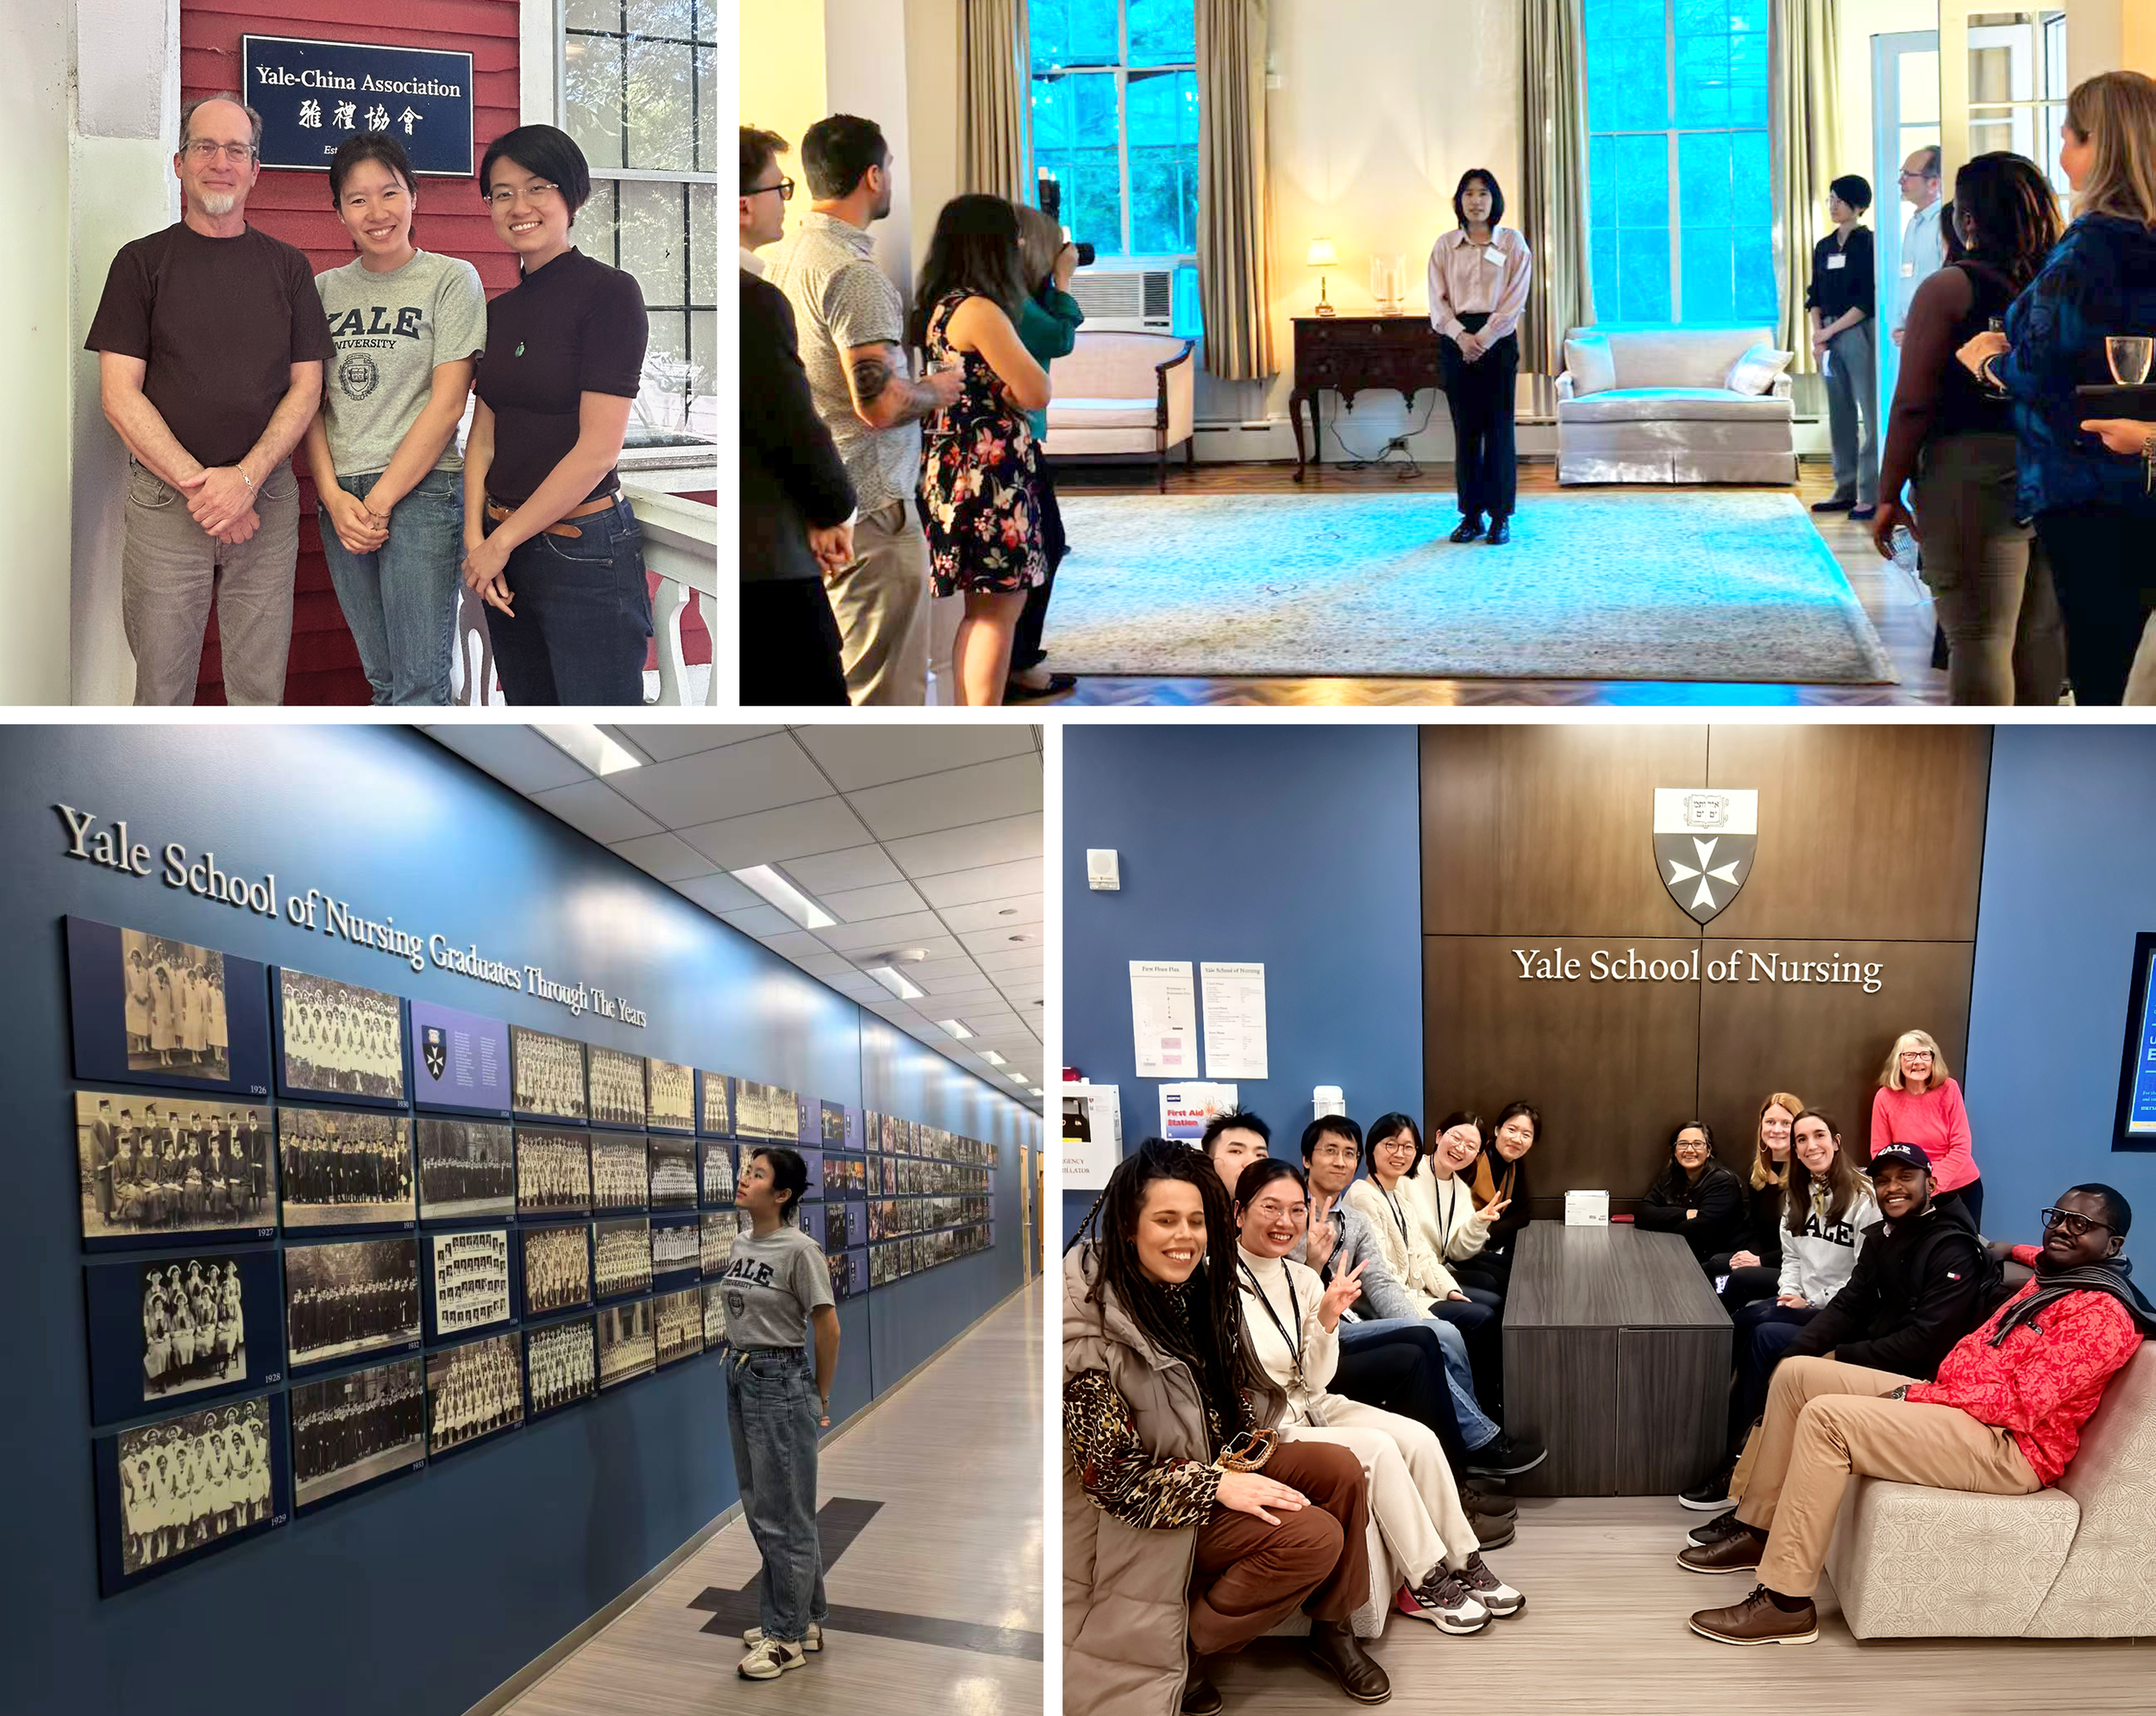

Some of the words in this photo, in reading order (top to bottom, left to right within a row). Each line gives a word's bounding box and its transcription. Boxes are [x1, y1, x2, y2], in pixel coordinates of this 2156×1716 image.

[256, 66, 356, 91] Yale-China
[360, 74, 461, 97] Association
[298, 99, 423, 135] 雅禮協會
[335, 338, 397, 349] NIVERSITY
[53, 804, 152, 875] Yale
[165, 842, 279, 917] School
[287, 889, 319, 930] of
[323, 896, 424, 971] Nursing
[429, 934, 521, 990] Graduates
[524, 964, 588, 1016] Through
[590, 987, 615, 1018] The
[616, 997, 646, 1027] Years
[1512, 948, 1581, 980] Yale
[1589, 948, 1701, 981] School
[1707, 949, 1744, 981] of
[1747, 952, 1883, 993] Nursing
[251, 1085, 266, 1094] 1926
[258, 1228, 273, 1237] 1927
[1800, 1212, 1855, 1248] ALE
[408, 1342, 419, 1350] 1932
[265, 1373, 281, 1383] 1928
[412, 1460, 425, 1470] 1933
[271, 1514, 286, 1526] 1929
